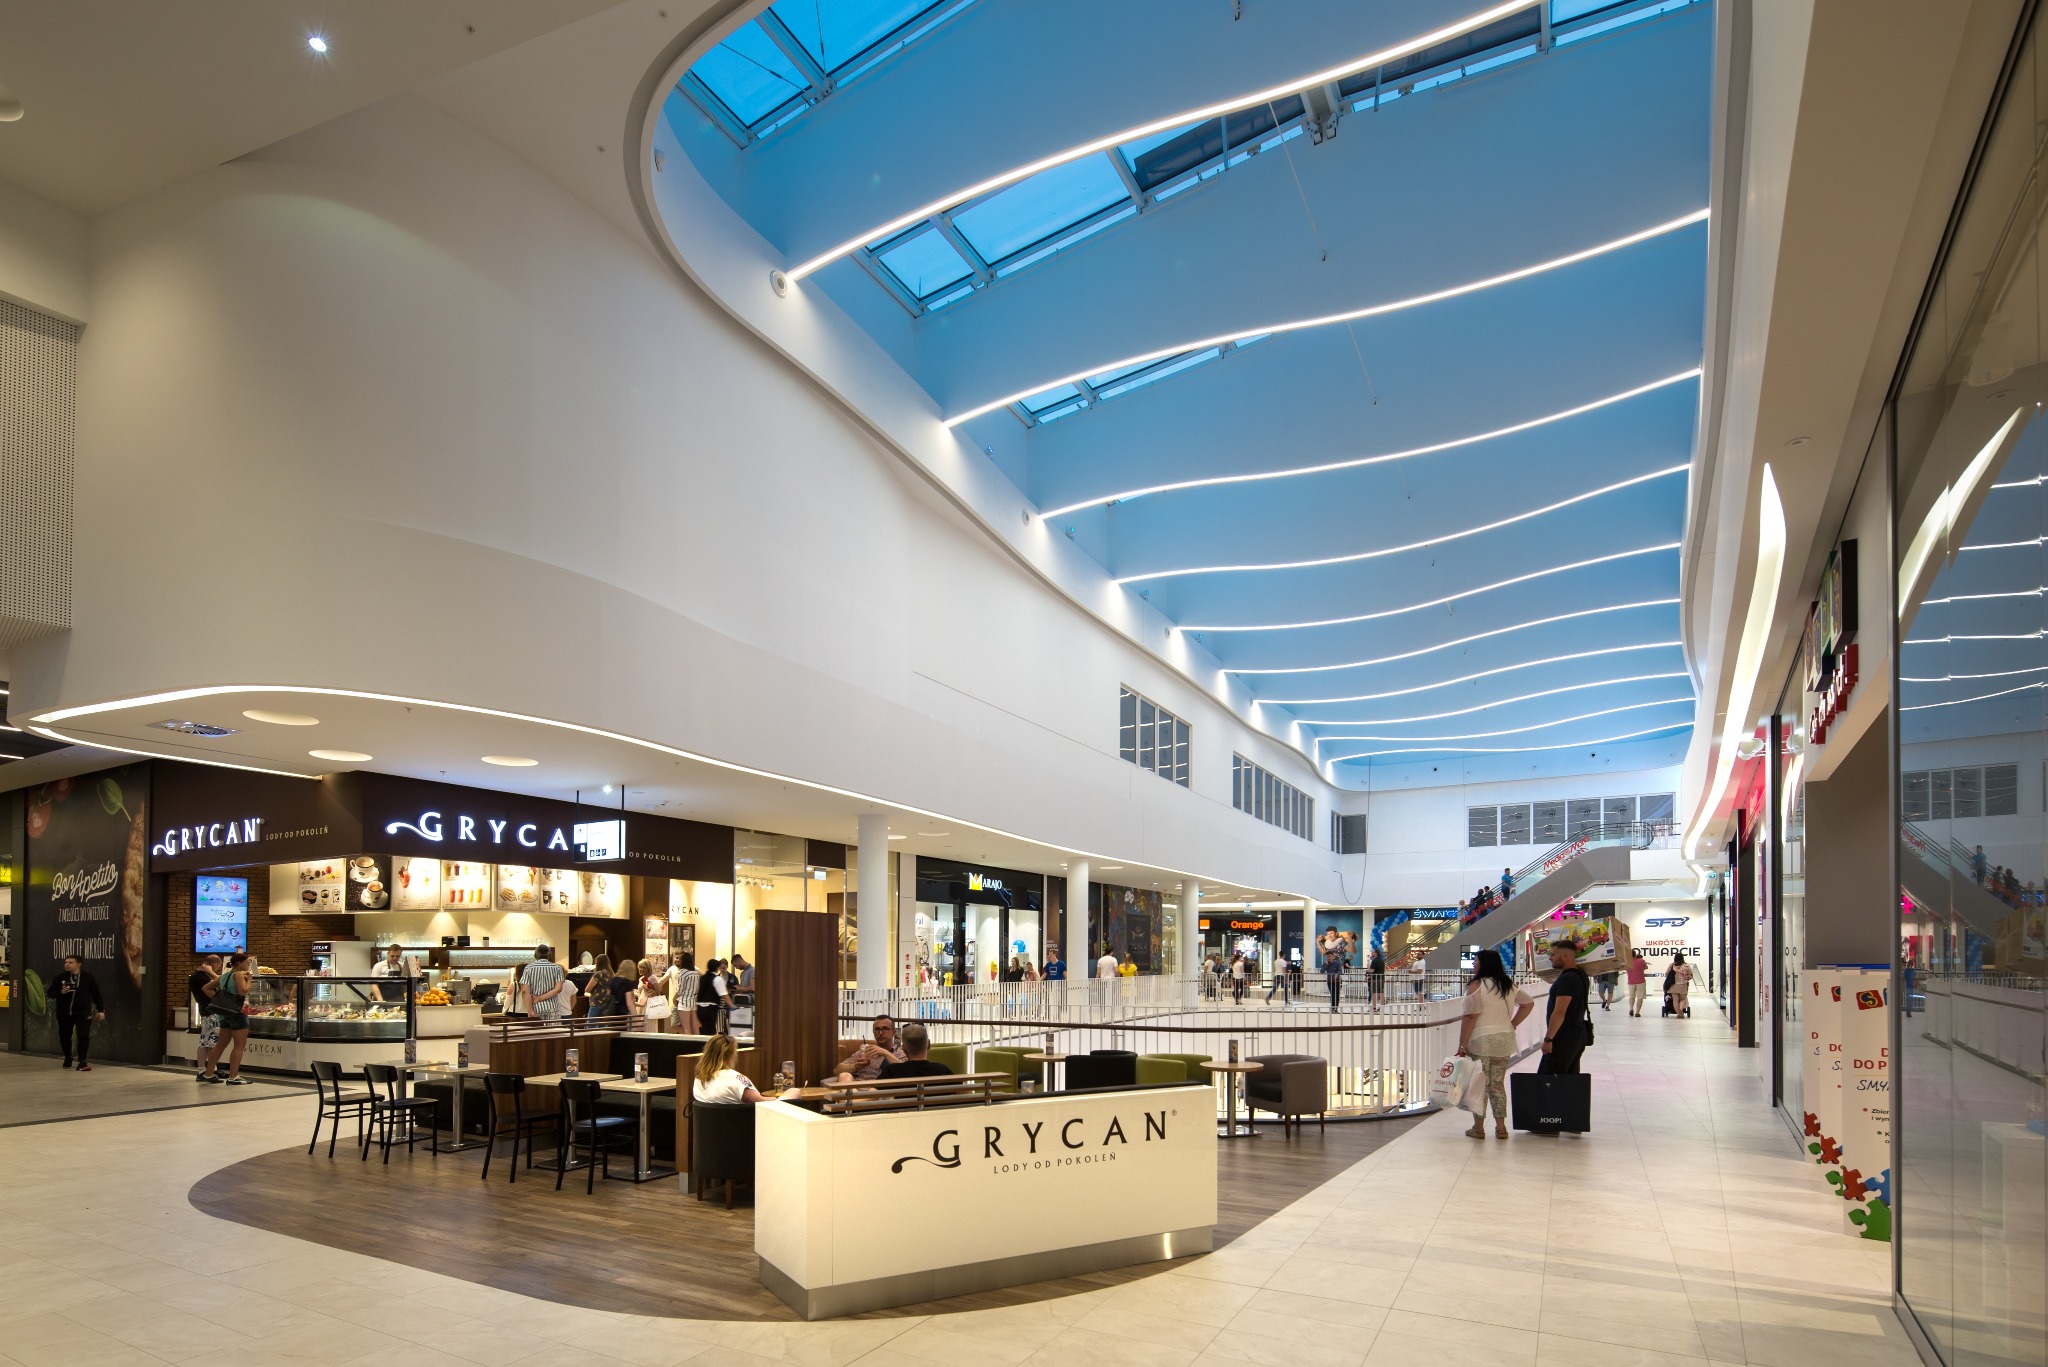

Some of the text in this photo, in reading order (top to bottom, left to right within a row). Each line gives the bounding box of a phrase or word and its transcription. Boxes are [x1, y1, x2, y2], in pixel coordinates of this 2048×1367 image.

[152, 818, 329, 856] GRYCAN LODY OD POKOLEŃ
[385, 811, 569, 851] GRYCA
[1230, 920, 1265, 930] Orange
[1644, 916, 1690, 928] SFD
[84, 931, 115, 959] WKRÓTCE!
[1645, 938, 1686, 946] WKRÓTCE
[1632, 947, 1701, 957] OTWARCIE
[244, 1043, 282, 1055] GRYCAN
[1853, 1059, 1875, 1070] DO
[1856, 1079, 1889, 1092] SMY
[891, 1111, 1166, 1174] GRYCAN
[993, 1151, 1117, 1174] LODY OD POKOLEŃ
